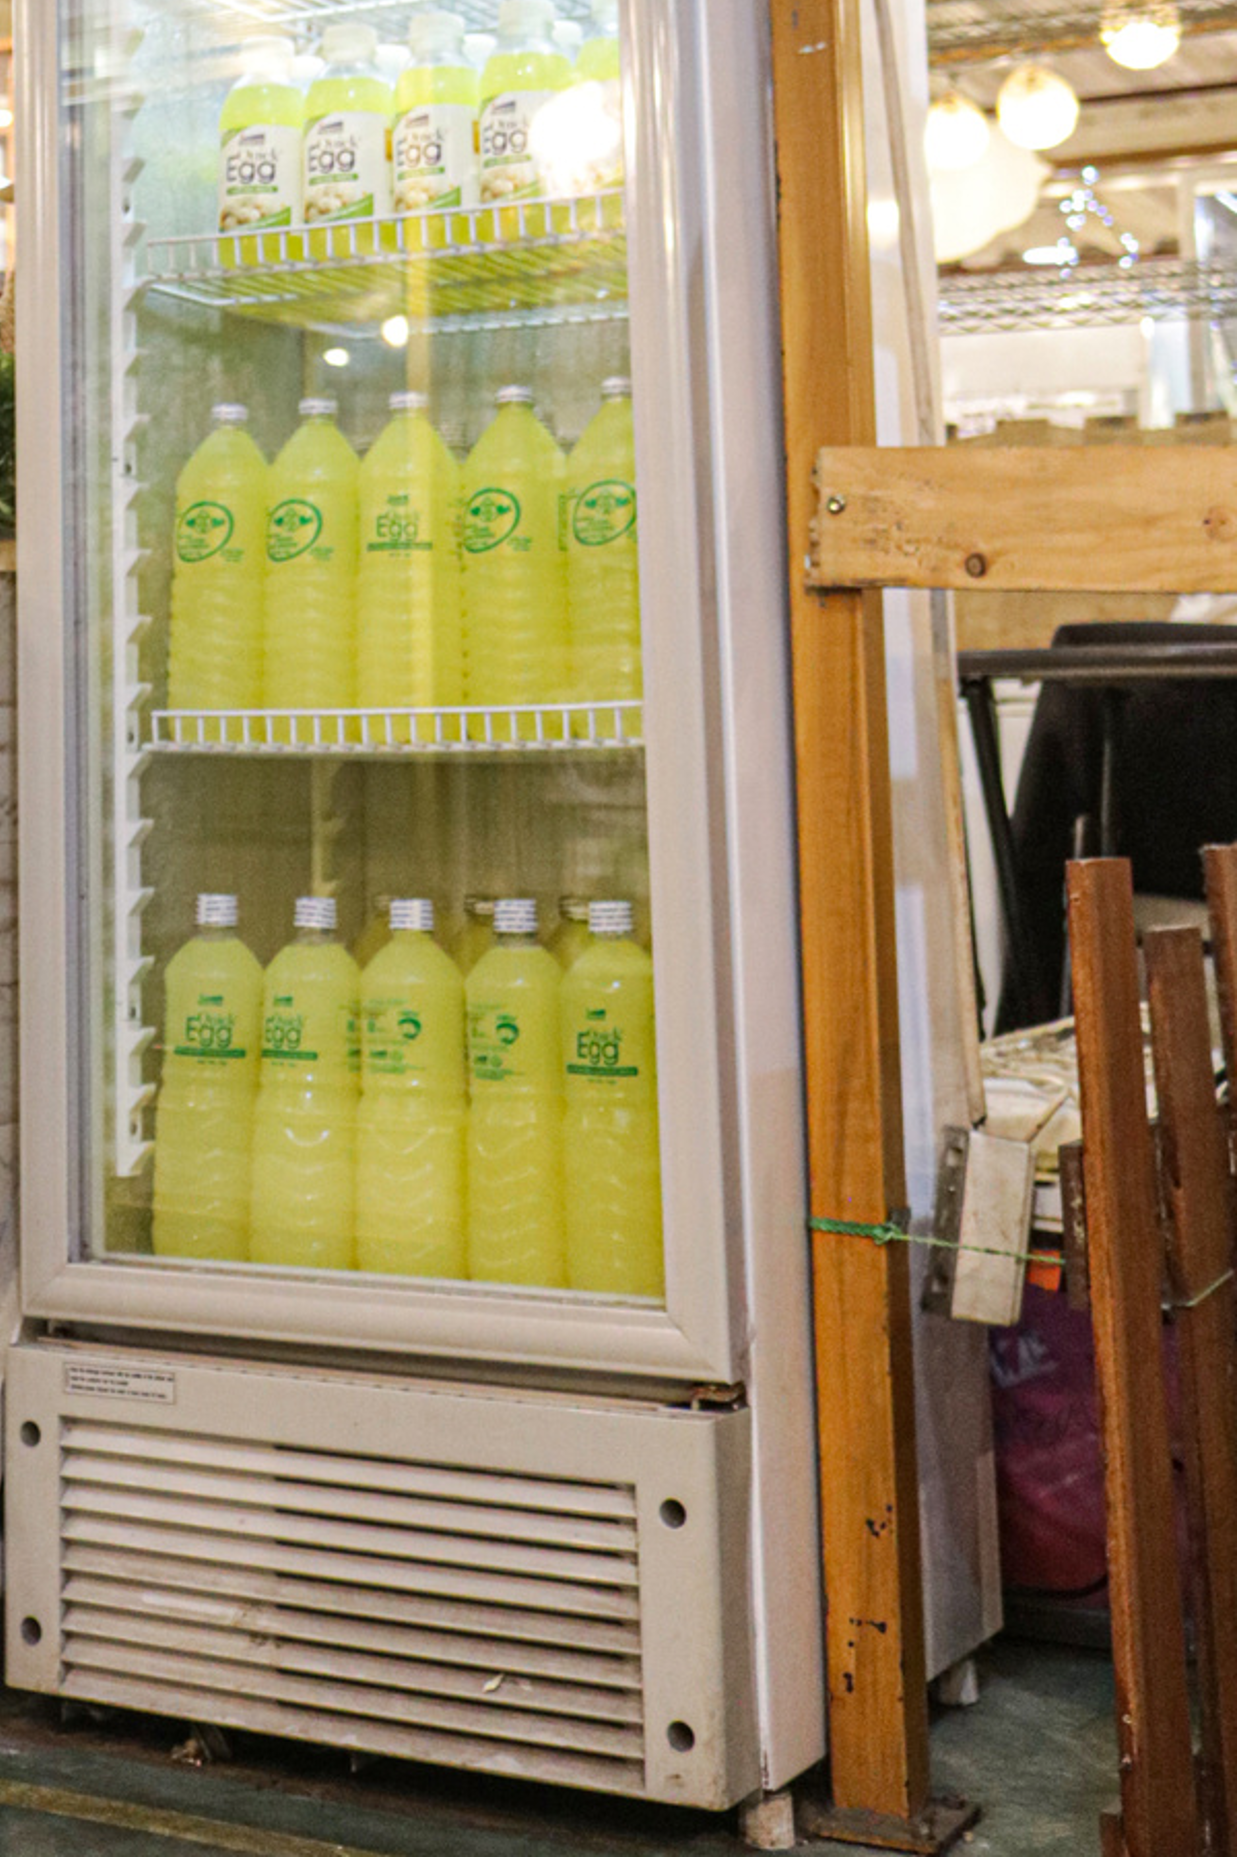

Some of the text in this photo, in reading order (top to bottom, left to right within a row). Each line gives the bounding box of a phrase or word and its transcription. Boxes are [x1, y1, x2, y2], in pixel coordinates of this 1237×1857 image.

[308, 145, 356, 174] Egg
[397, 138, 442, 168] Egg
[226, 153, 276, 185] Egg
[376, 513, 418, 543] Egg
[186, 1015, 233, 1049] Egg
[575, 1030, 620, 1066] Egg
